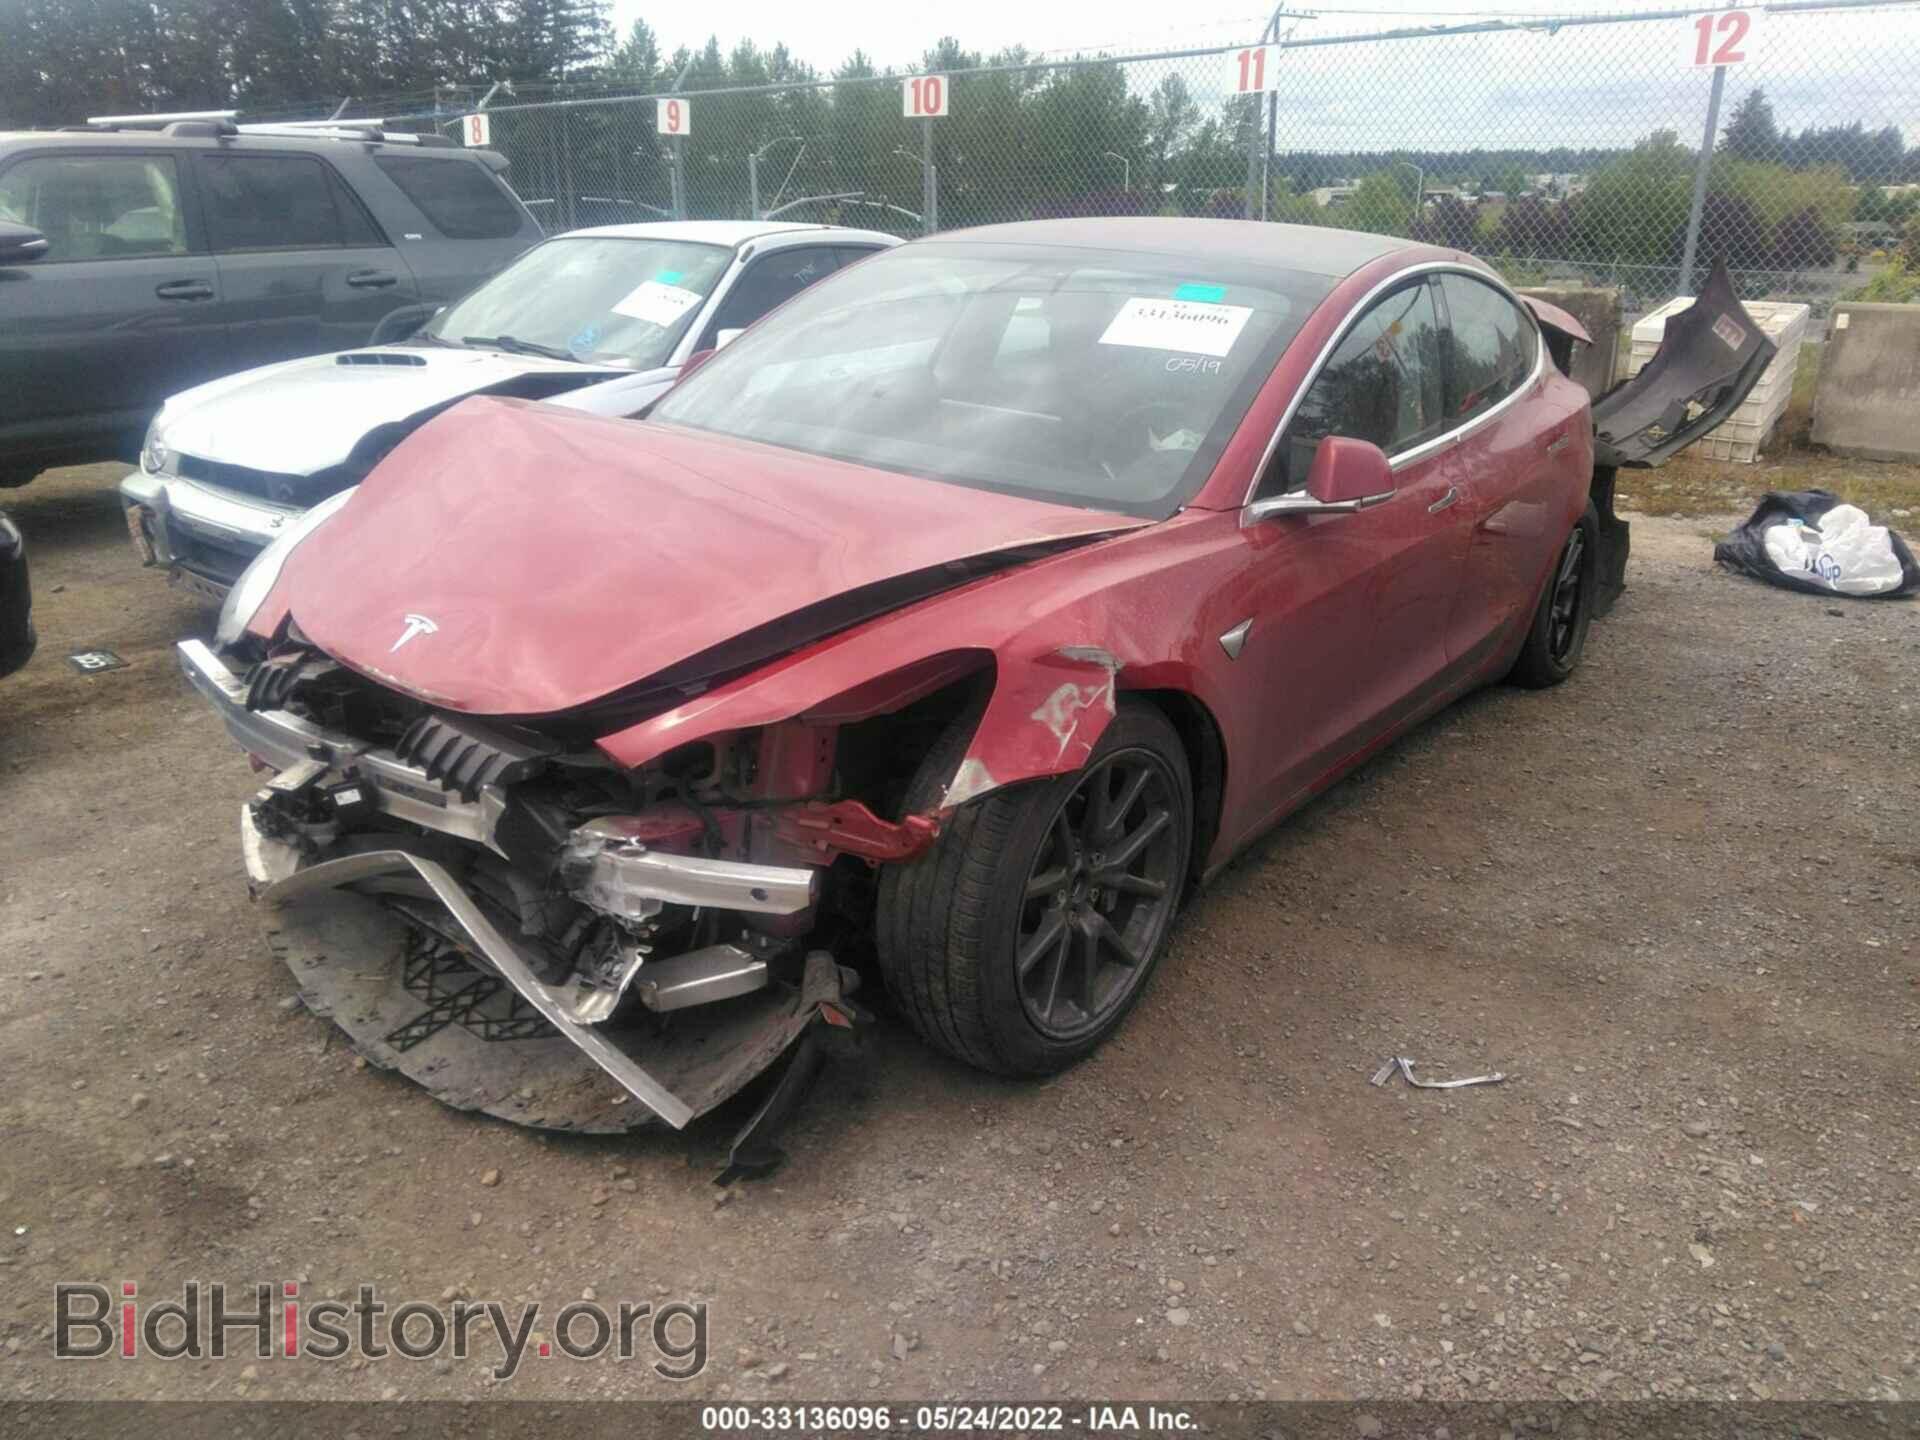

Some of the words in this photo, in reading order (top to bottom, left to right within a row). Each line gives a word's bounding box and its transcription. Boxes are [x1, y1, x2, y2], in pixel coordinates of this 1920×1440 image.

[1695, 11, 1750, 64] 12
[1238, 48, 1265, 90] 11
[911, 77, 941, 114] 10
[471, 116, 482, 144] 8
[666, 100, 681, 132] 9
